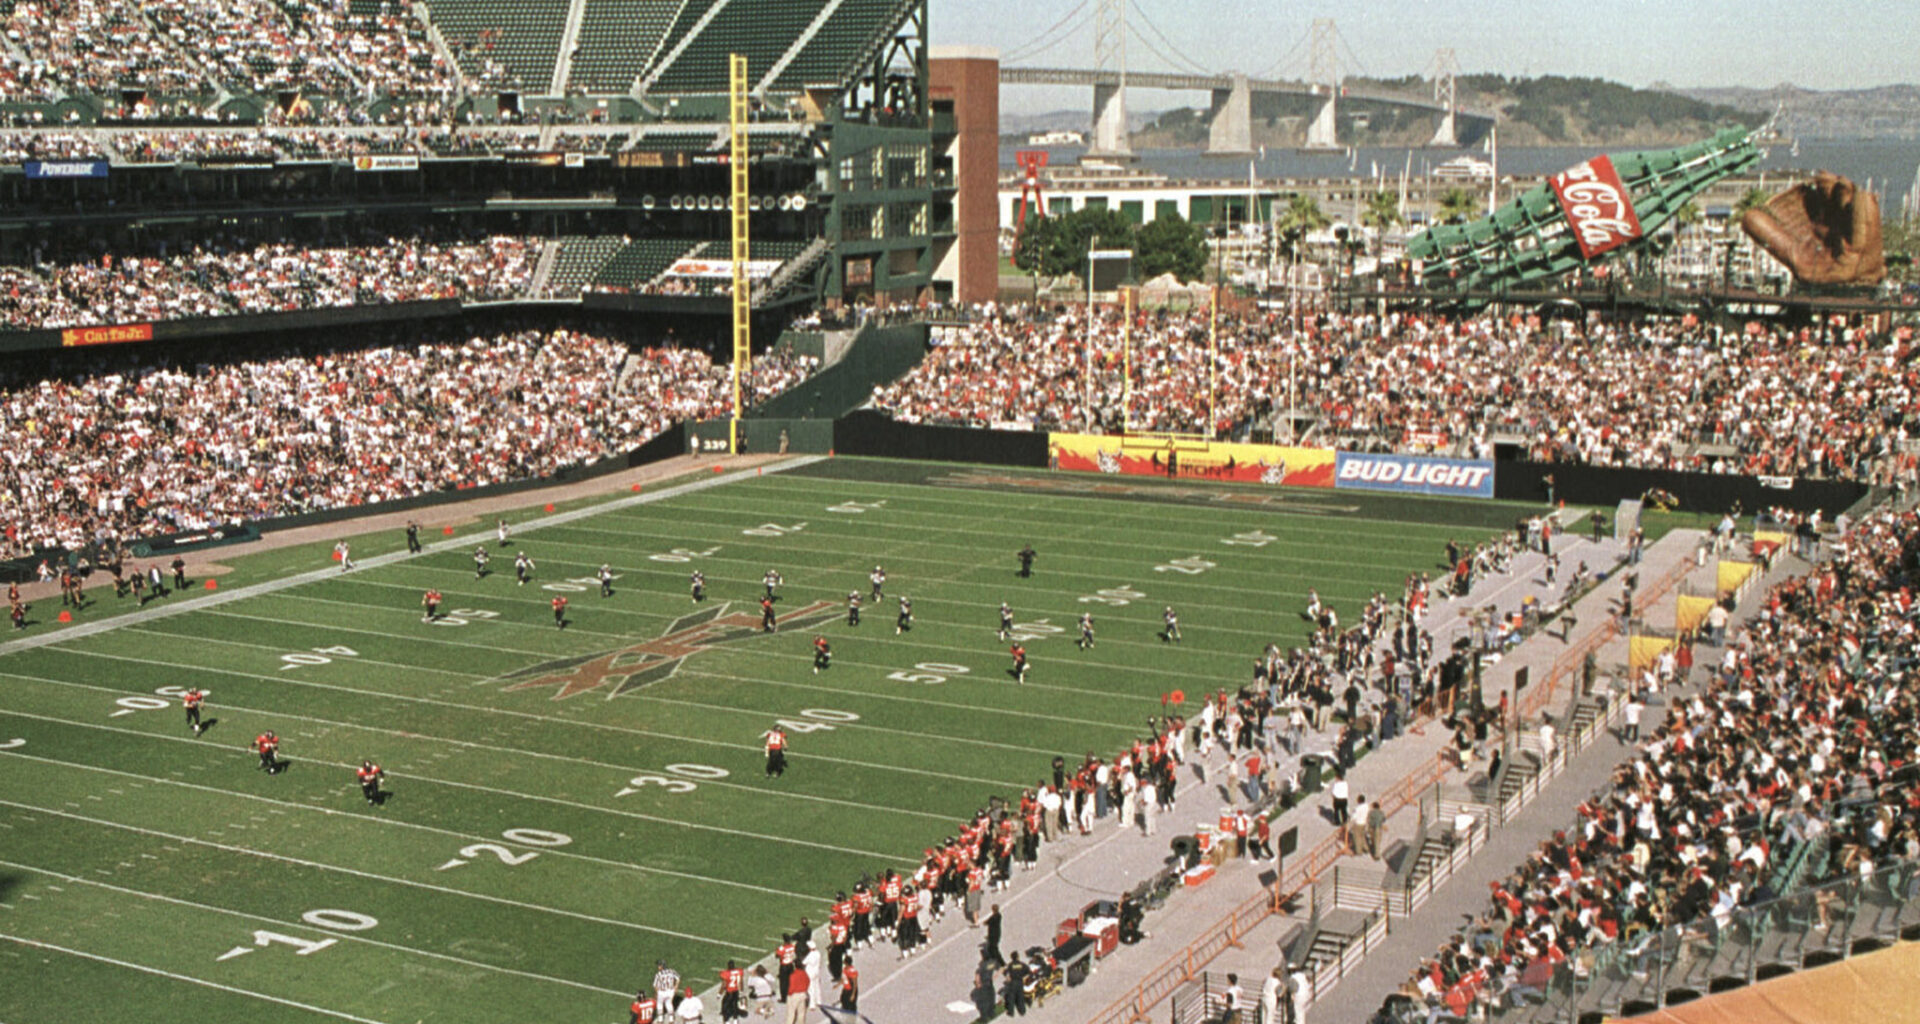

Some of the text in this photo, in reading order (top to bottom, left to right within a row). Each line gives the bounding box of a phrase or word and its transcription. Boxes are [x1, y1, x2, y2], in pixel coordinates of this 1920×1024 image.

[1339, 459, 1490, 489] BUD LIGHT
[281, 645, 360, 665] 40
[886, 662, 971, 685] 50
[776, 708, 861, 733] 40
[630, 763, 731, 793] 30
[460, 828, 573, 866] 20
[253, 909, 379, 955] 10
